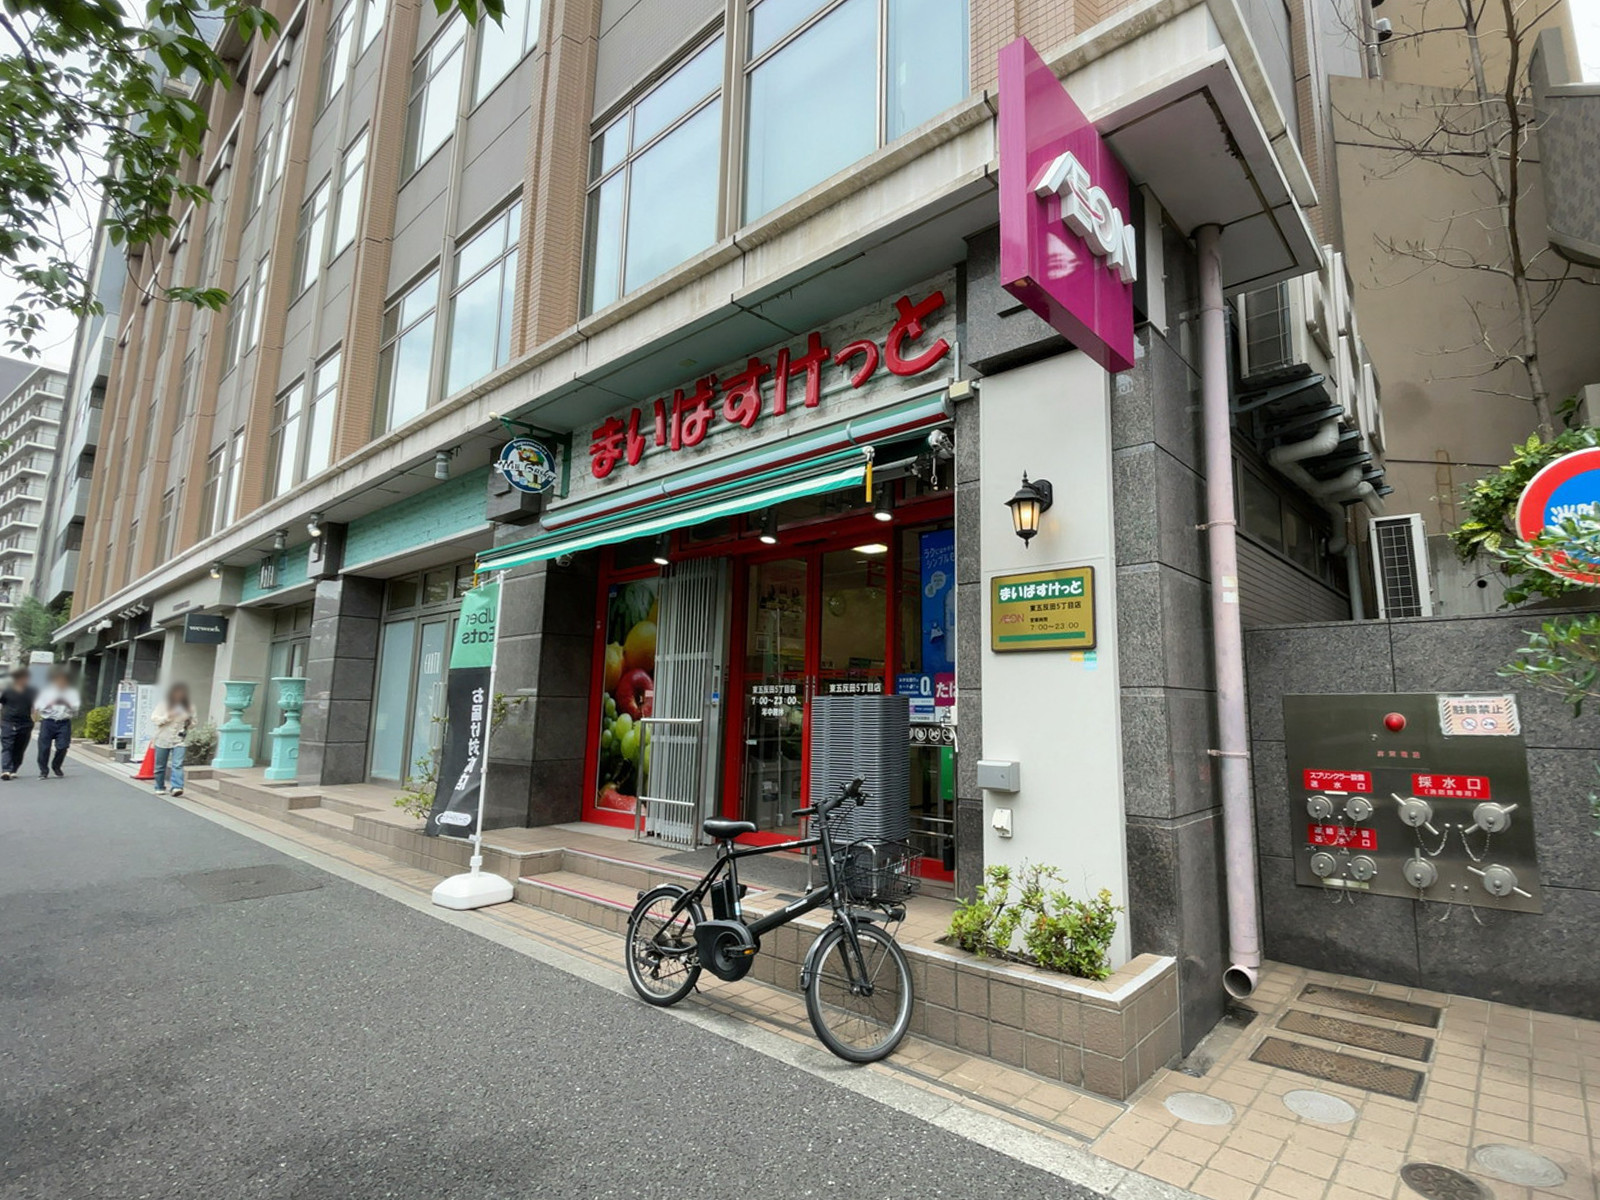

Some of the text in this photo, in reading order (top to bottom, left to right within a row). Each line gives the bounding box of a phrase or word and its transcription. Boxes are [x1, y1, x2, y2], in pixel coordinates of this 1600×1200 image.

[589, 290, 950, 478] まいばすけっと
[999, 580, 1082, 601] まいばすけっと
